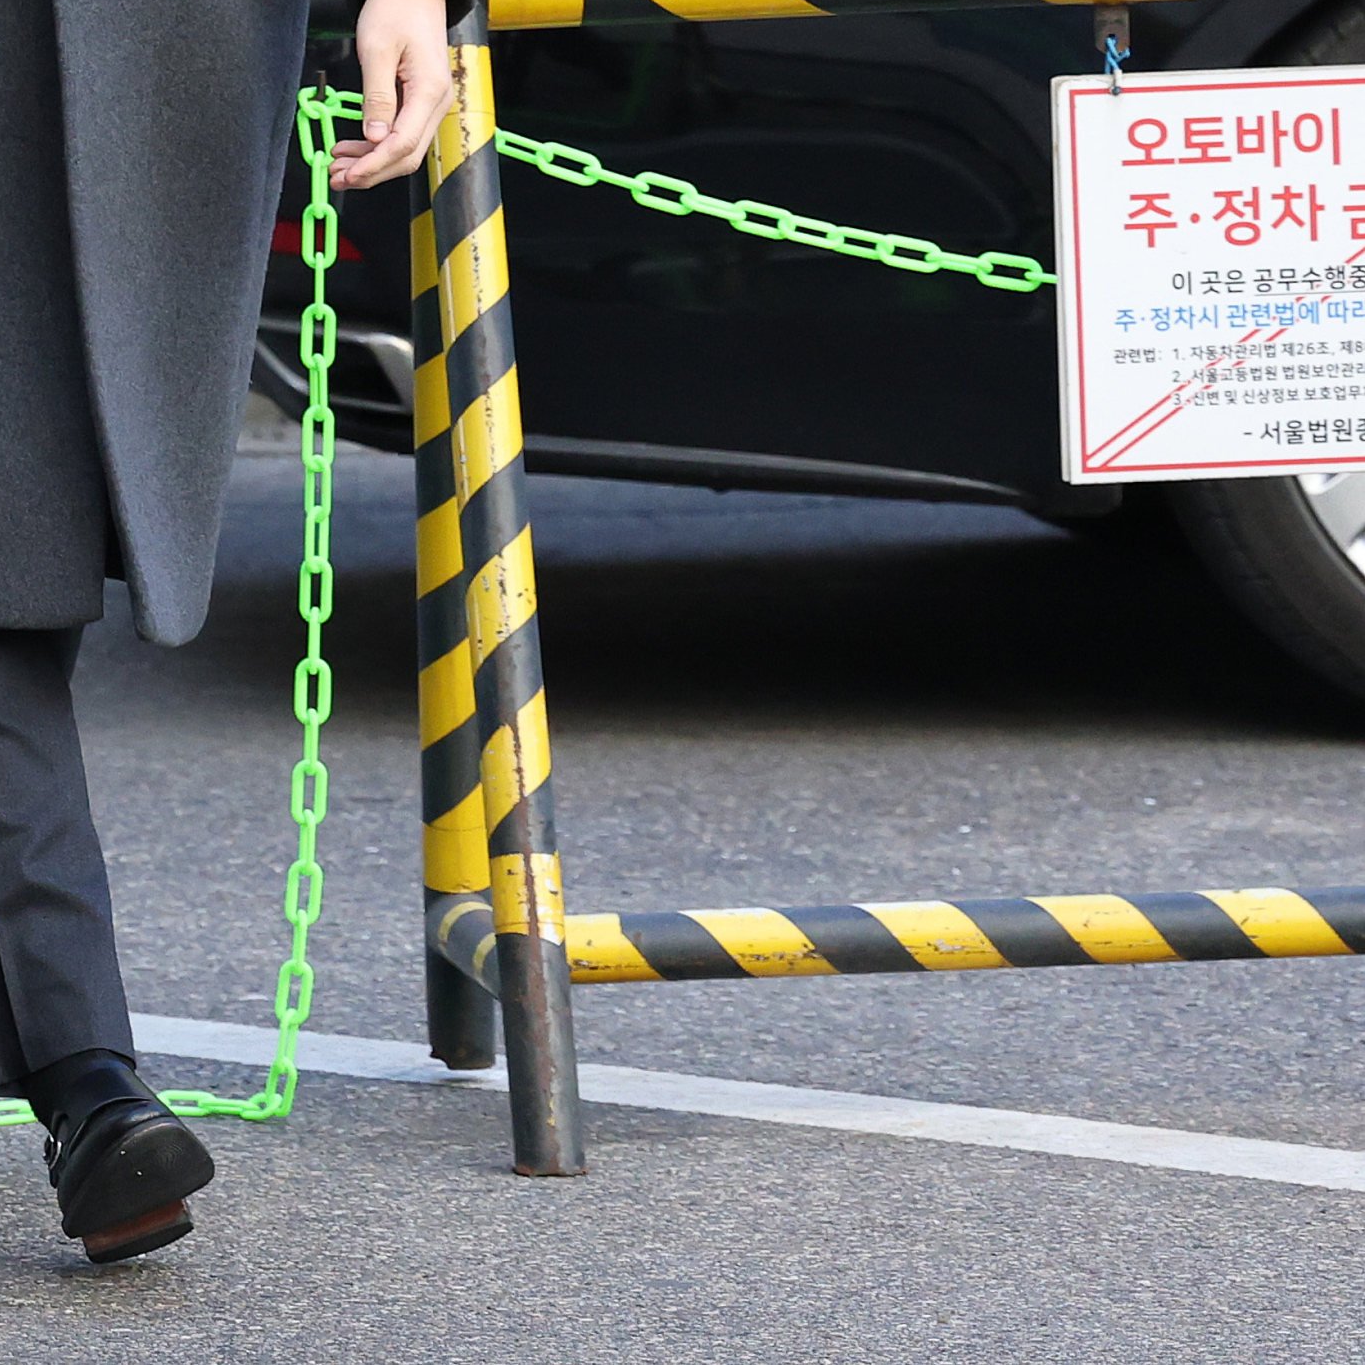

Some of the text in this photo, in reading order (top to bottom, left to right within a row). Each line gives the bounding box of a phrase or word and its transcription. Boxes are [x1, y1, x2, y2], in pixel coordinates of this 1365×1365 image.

[1121, 107, 1342, 168] 오토바이
[1123, 183, 1326, 248] 주·정차
[1170, 264, 1365, 296] 이 곳은 공무수행중
[1114, 304, 1219, 332] 주·정차시
[1225, 299, 1321, 329] 관련법에
[1189, 342, 1277, 362] 자동차관리법
[1338, 338, 1365, 356] 제8
[1190, 365, 1279, 384] 서울고등법원
[1223, 389, 1239, 406] 및
[1241, 386, 1300, 406] 신상정보
[1303, 383, 1365, 404] 보호업무
